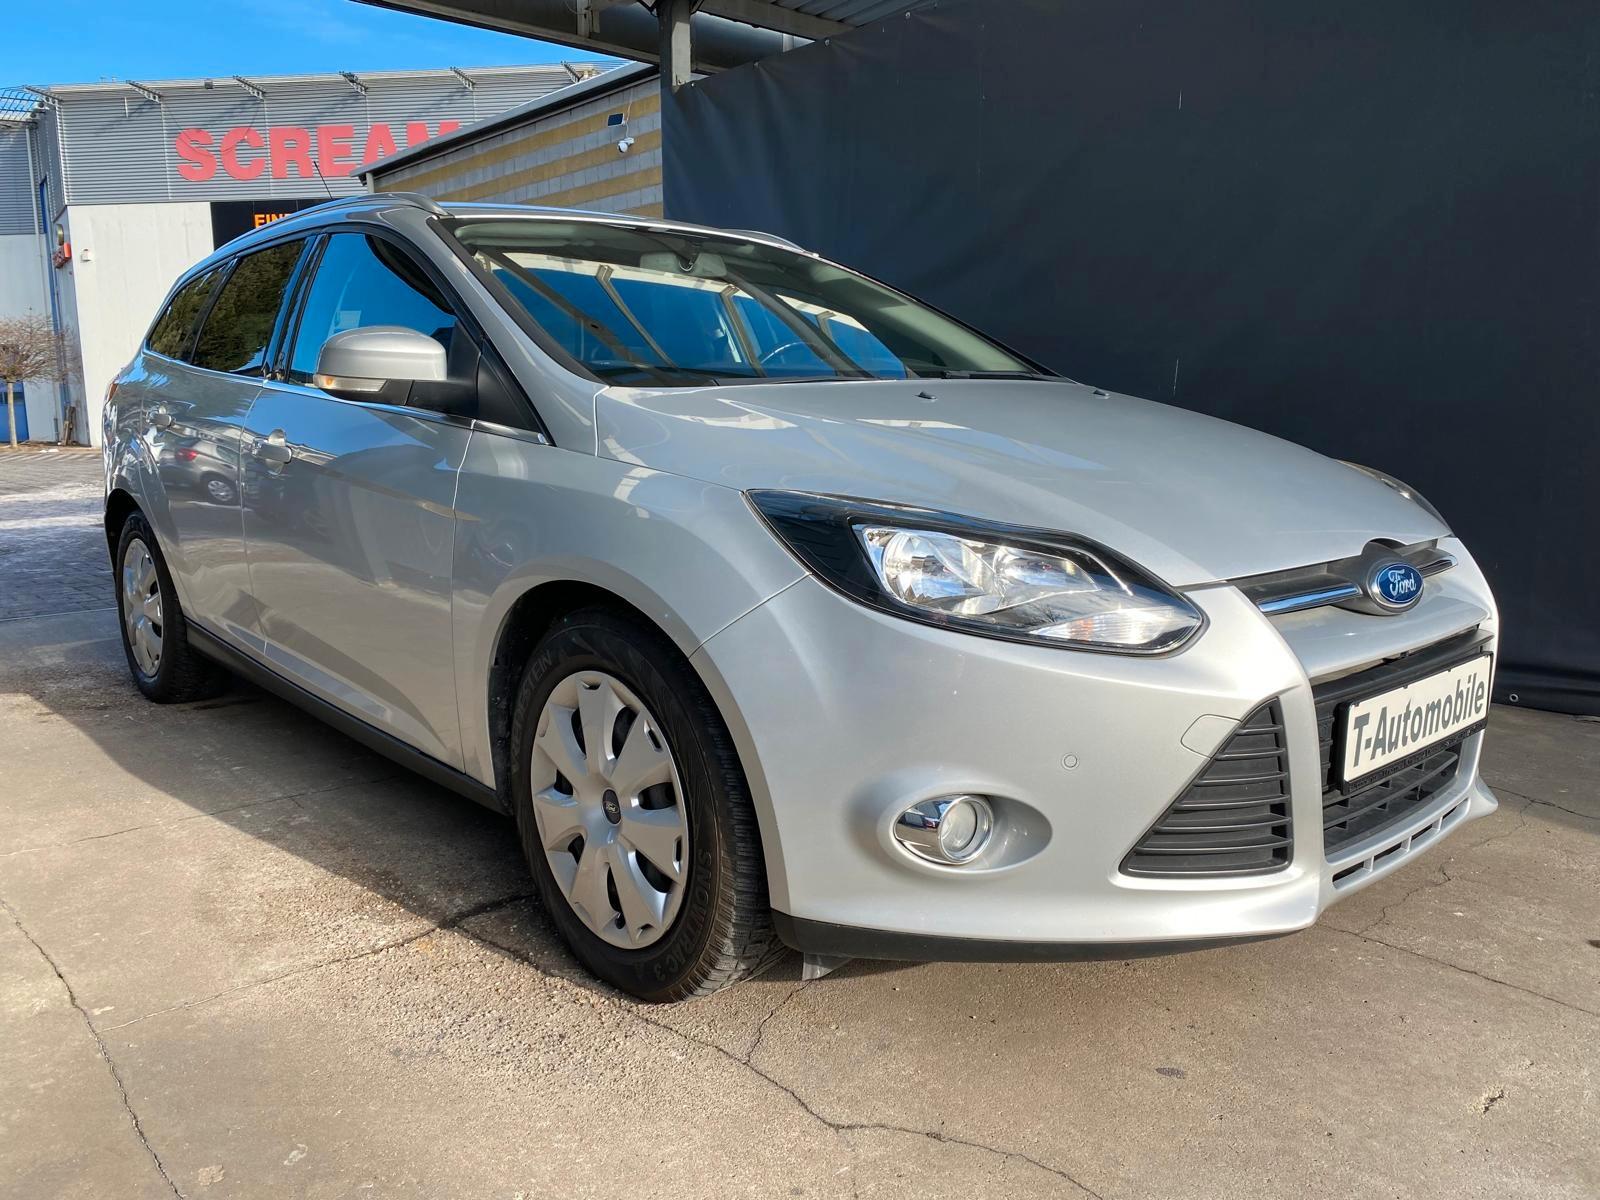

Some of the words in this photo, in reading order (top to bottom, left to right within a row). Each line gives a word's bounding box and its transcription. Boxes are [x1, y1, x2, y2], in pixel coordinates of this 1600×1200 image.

[1388, 568, 1417, 597] Ford
[1353, 672, 1485, 768] T-Automobile
[666, 848, 712, 973] SNOWTRAC
[654, 962, 667, 982] 3
